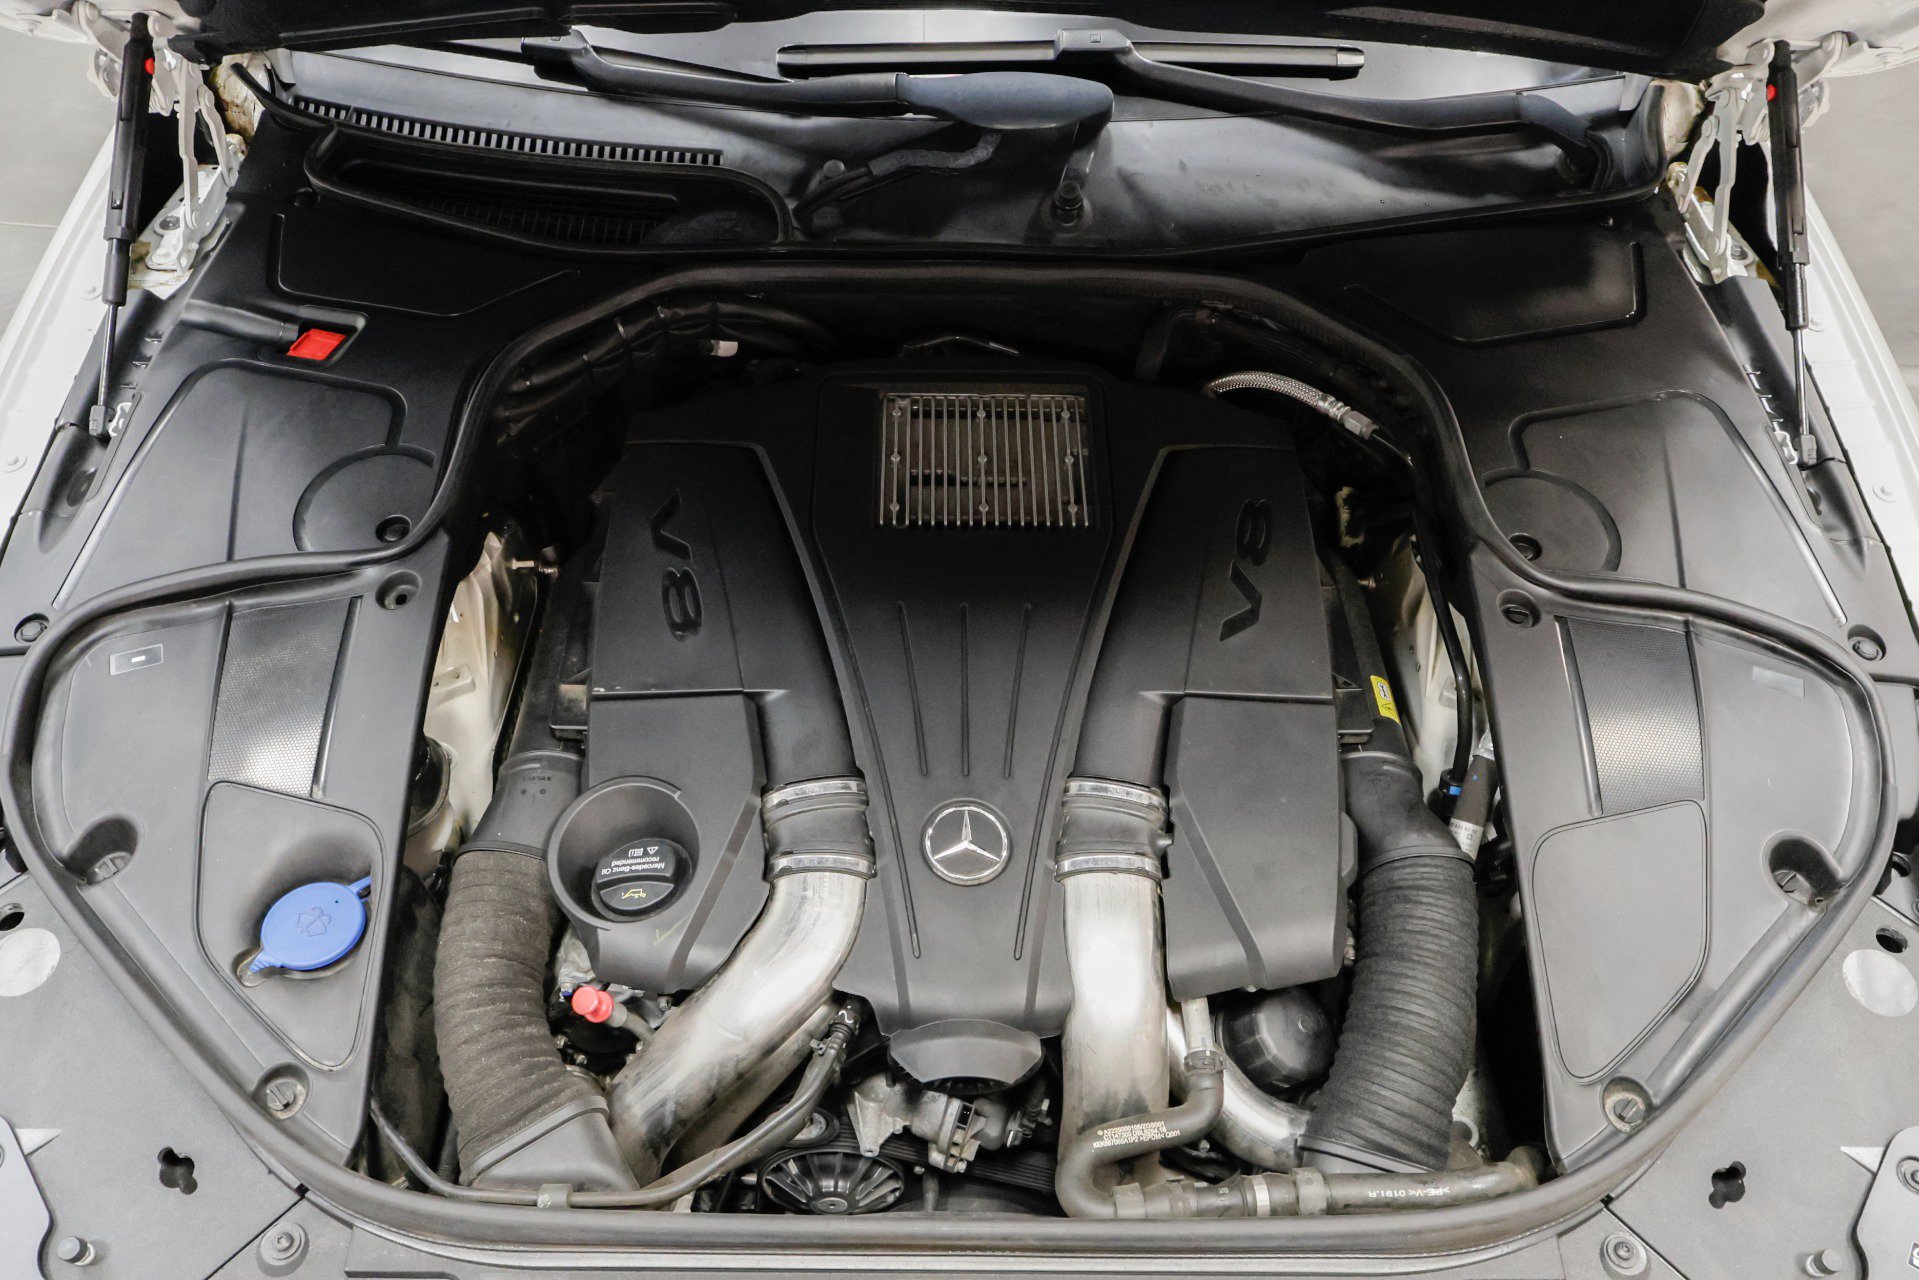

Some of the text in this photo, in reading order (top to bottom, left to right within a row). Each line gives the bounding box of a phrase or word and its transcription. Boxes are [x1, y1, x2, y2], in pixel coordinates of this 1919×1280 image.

[650, 488, 704, 642] V8
[1219, 498, 1273, 642] V8
[601, 862, 665, 875] Mercedes-Benz Oil
[611, 856, 659, 867] recommended
